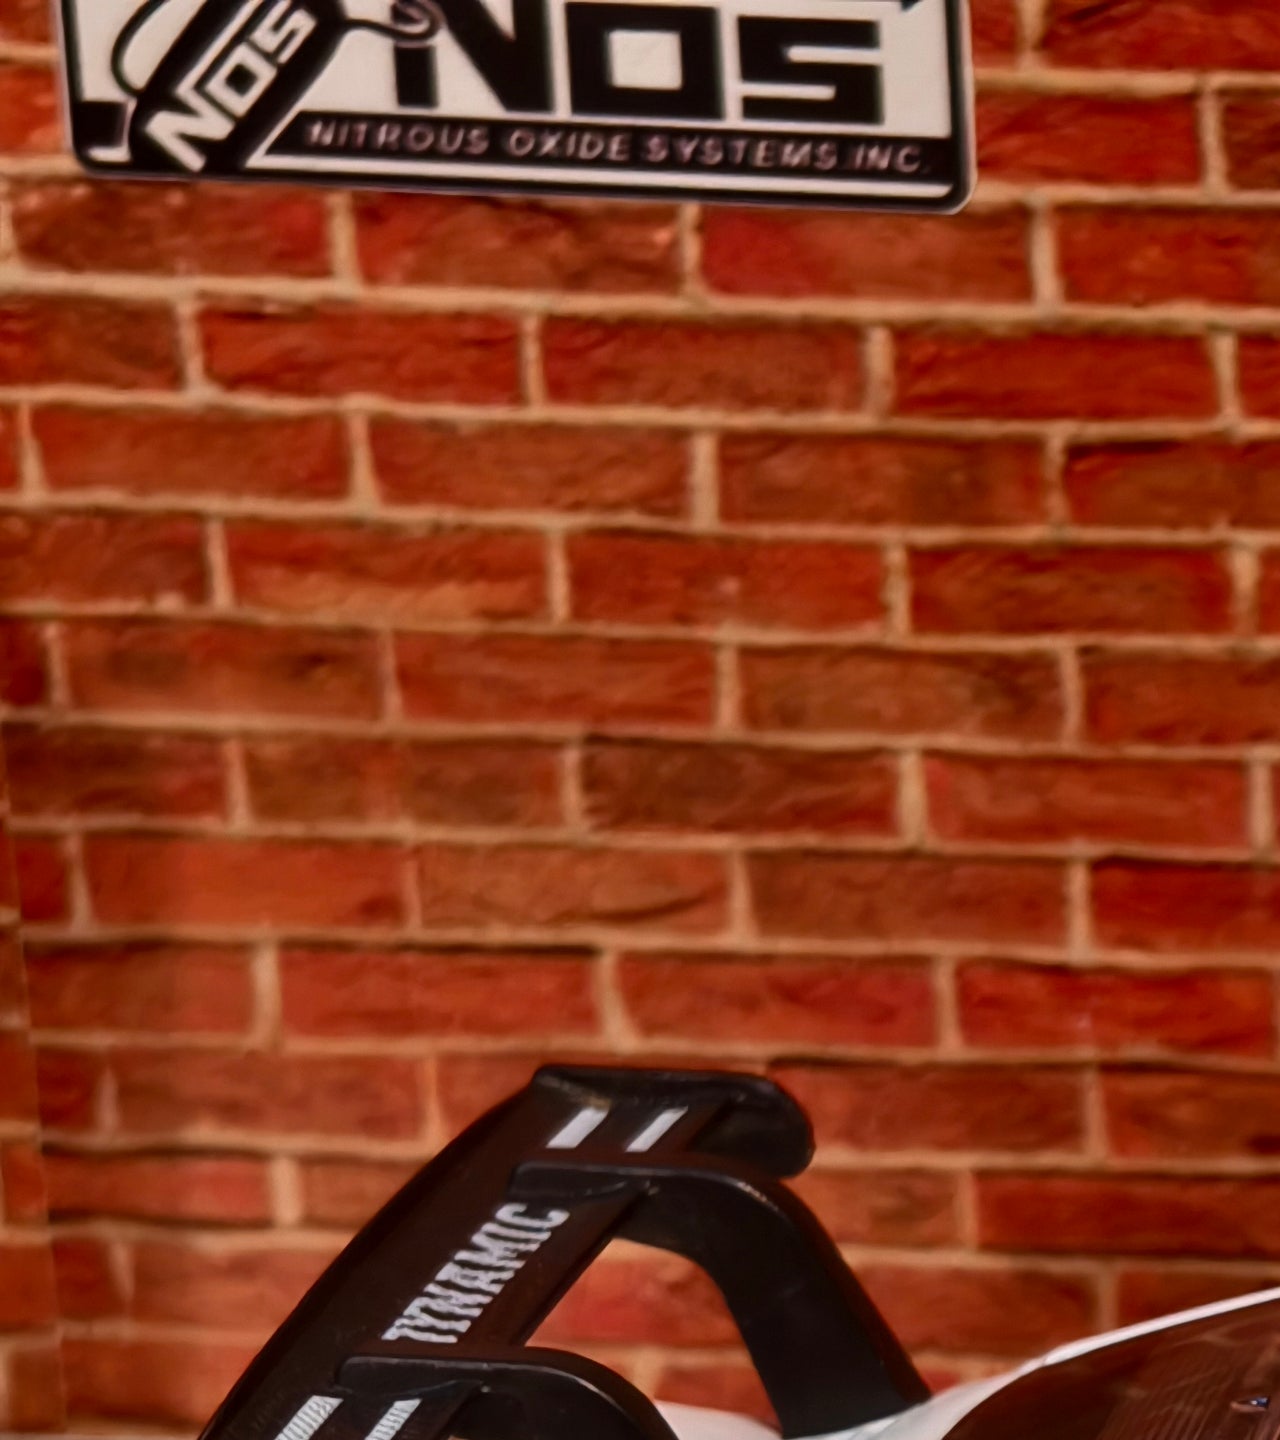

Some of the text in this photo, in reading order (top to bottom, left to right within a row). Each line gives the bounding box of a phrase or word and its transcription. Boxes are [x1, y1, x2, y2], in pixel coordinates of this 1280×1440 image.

[144, 0, 317, 172] NOS
[393, 0, 883, 124] NOS
[306, 119, 490, 155] NITROUS
[507, 128, 631, 161] OXIDE
[645, 134, 839, 172] SYSTEMS
